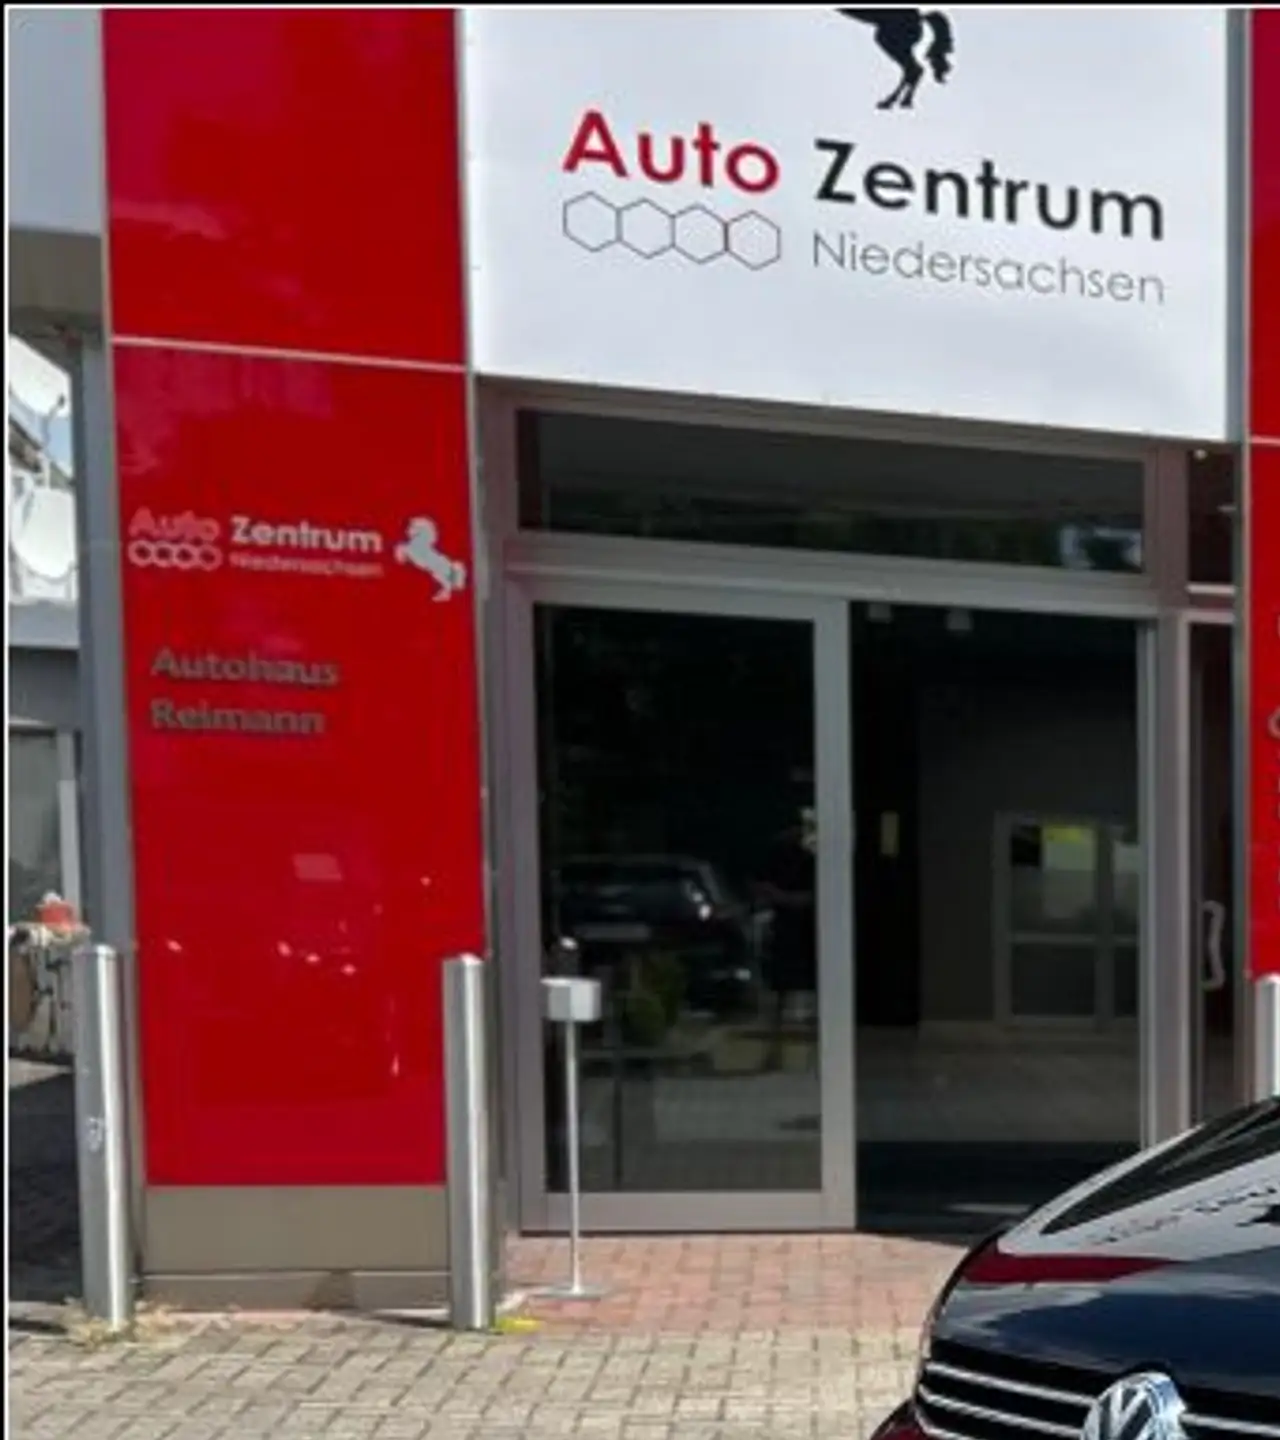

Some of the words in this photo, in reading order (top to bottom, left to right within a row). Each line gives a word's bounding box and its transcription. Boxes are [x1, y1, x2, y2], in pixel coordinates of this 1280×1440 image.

[562, 108, 781, 194] Auto
[814, 138, 1164, 241] Zentrum
[812, 230, 1164, 305] Niedersachsen
[128, 506, 221, 542] Auto
[230, 515, 383, 554] Zentrum
[152, 648, 338, 685] Autohaus
[150, 698, 325, 734] Reimann
